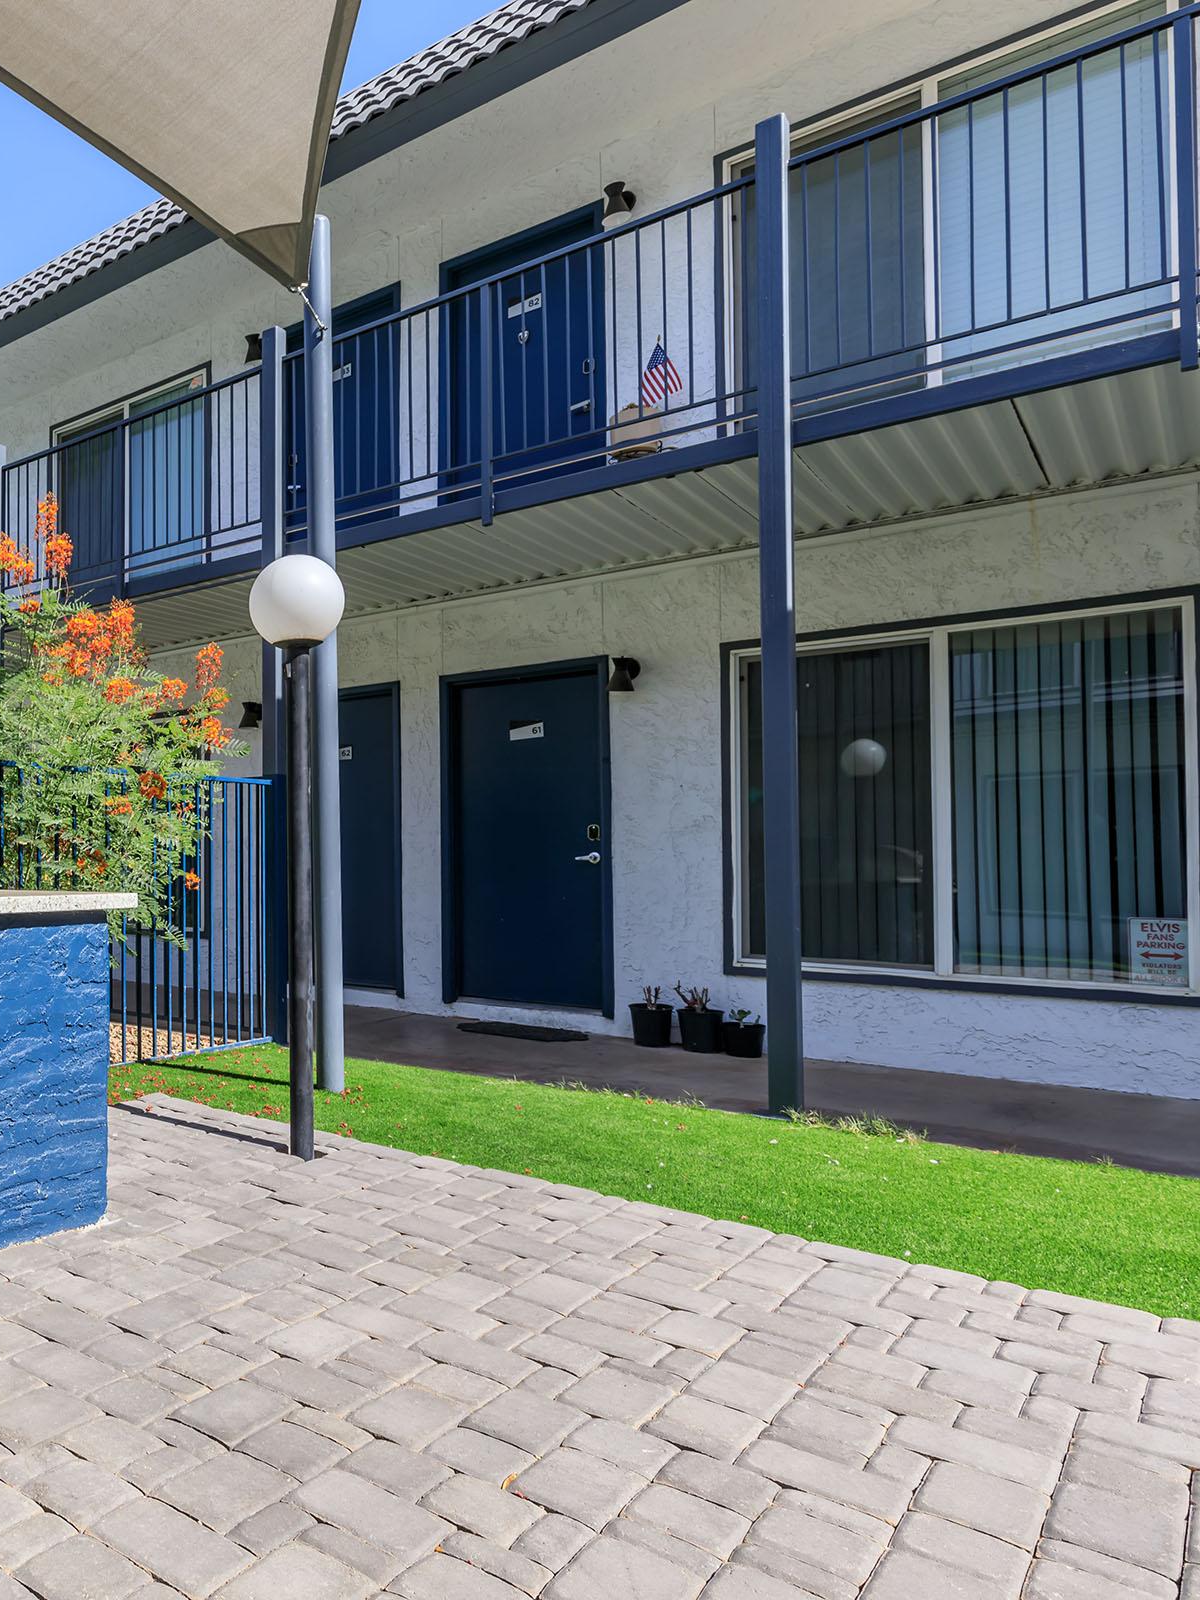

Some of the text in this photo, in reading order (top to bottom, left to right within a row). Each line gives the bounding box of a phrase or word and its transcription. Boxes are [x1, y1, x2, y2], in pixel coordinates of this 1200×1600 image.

[528, 298, 540, 307] 82
[1141, 922, 1180, 933] ELVIS
[1147, 933, 1175, 941] FANS
[1136, 941, 1185, 950] PARKING
